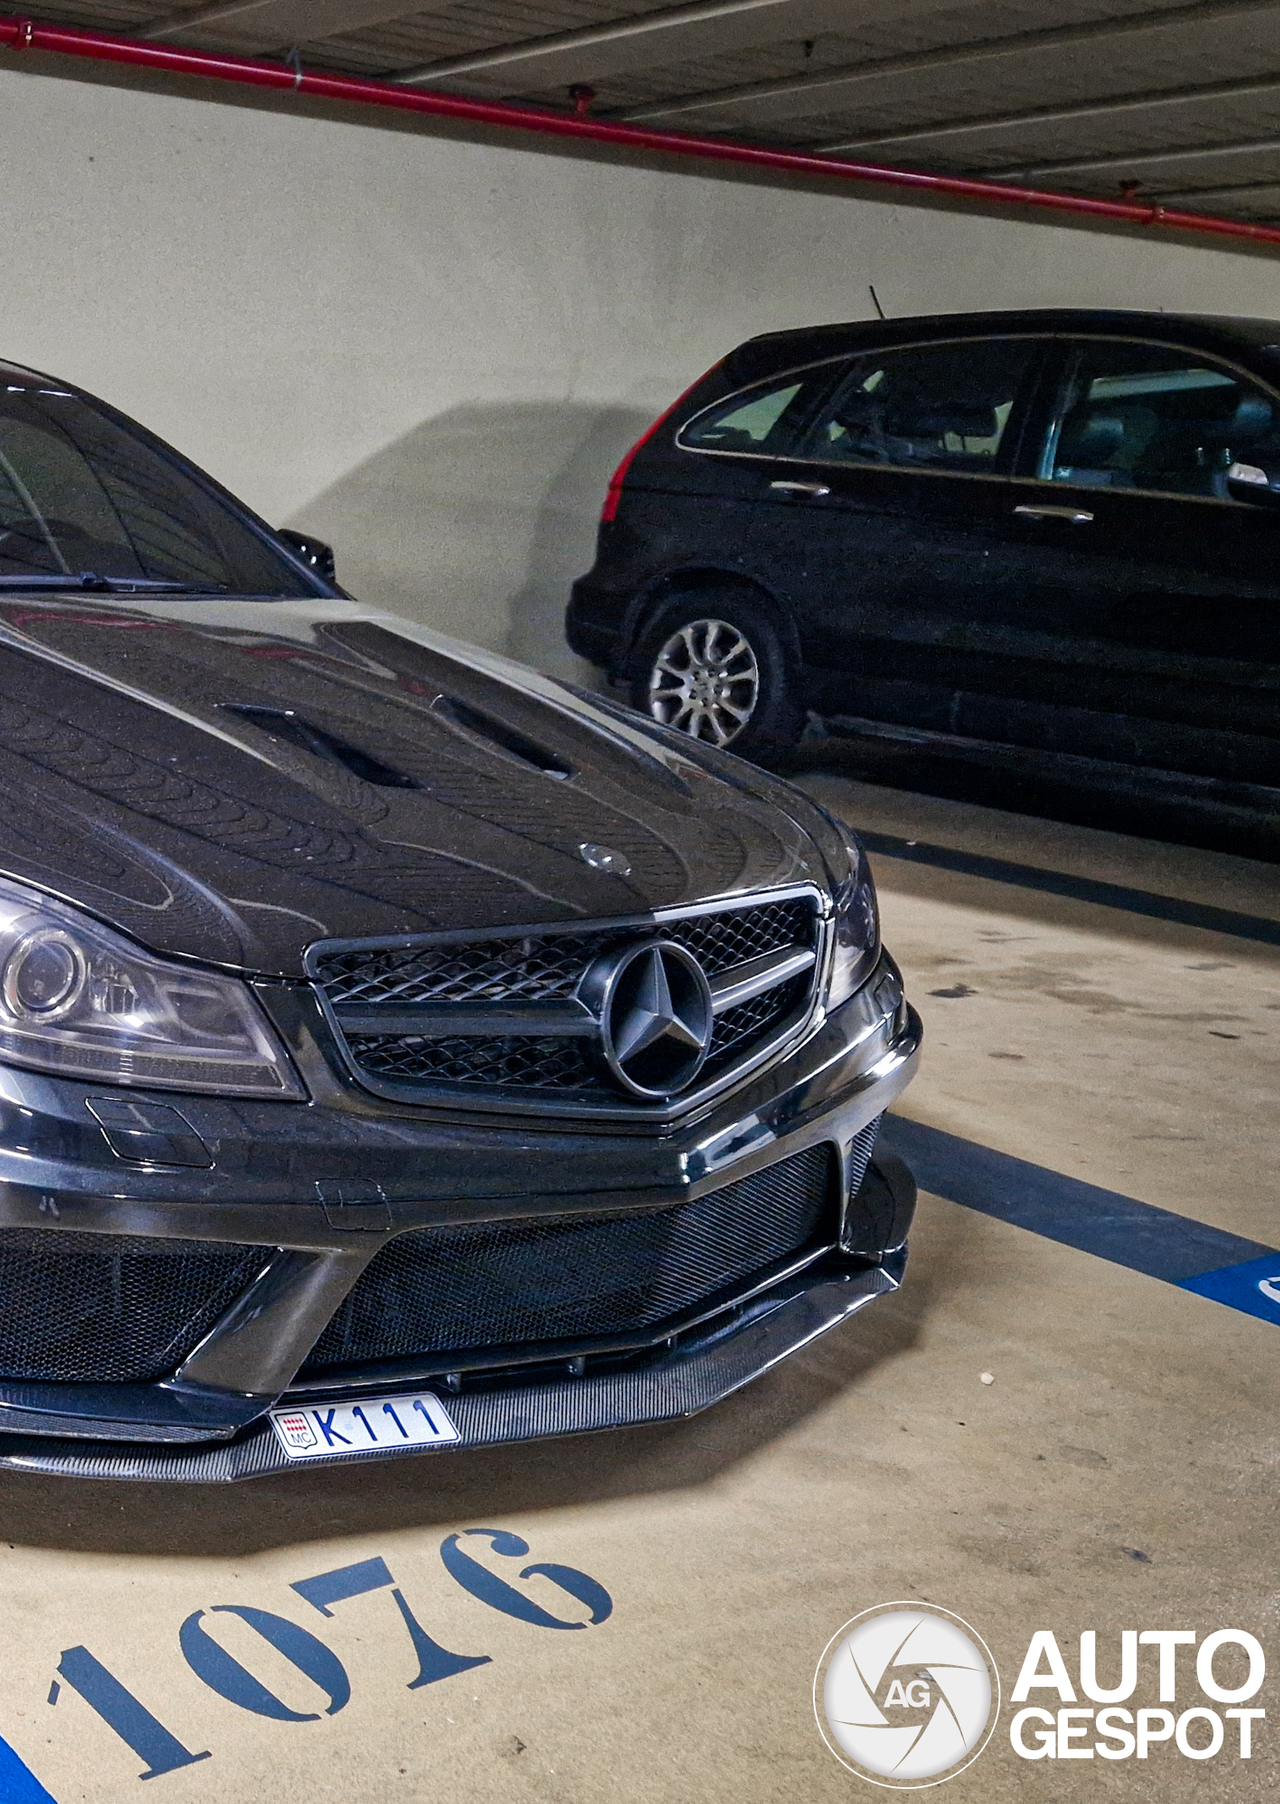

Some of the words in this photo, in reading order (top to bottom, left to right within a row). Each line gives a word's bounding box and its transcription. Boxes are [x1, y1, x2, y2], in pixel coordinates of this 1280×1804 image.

[291, 1431, 312, 1444] MC
[312, 1400, 440, 1447] K111
[48, 1528, 613, 1780] 1076
